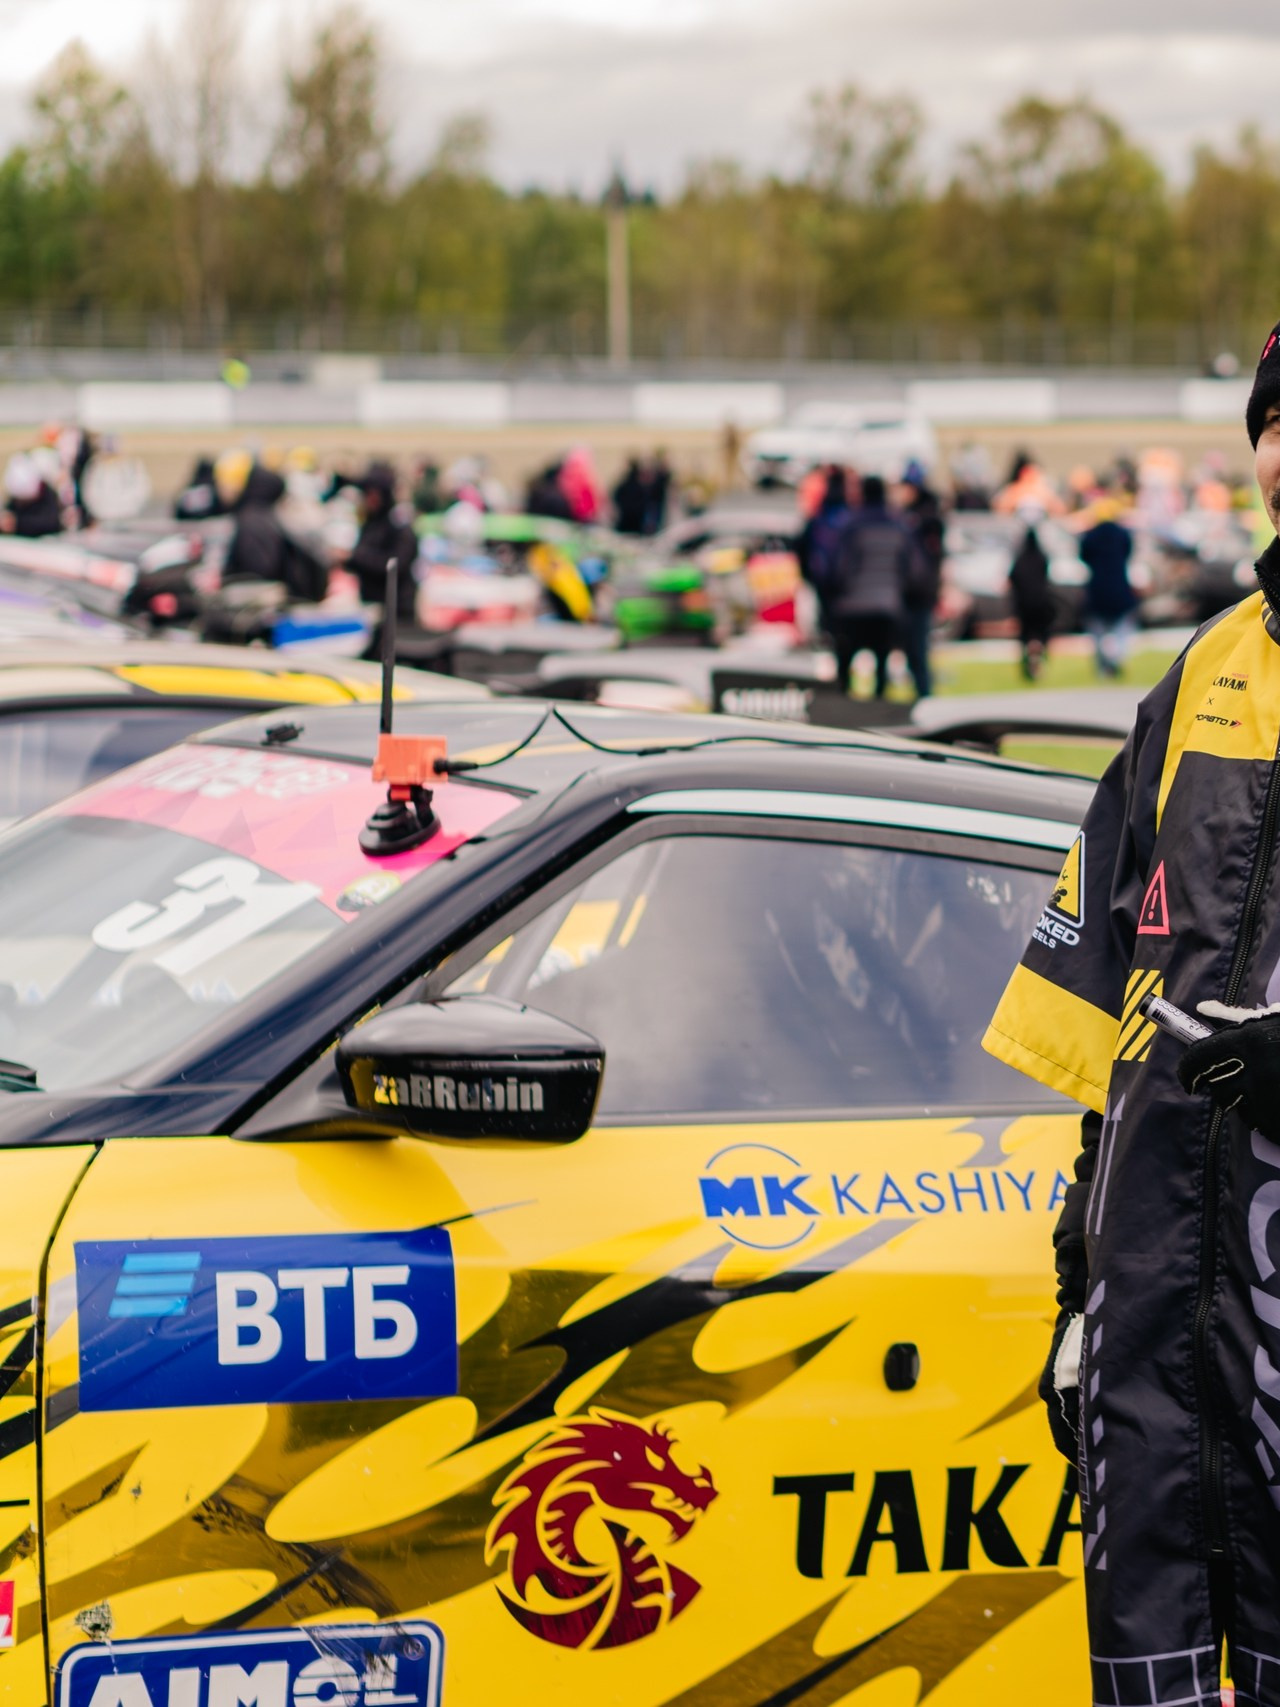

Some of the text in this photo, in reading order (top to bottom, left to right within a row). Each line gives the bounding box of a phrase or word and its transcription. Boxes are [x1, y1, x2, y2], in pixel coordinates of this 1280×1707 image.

[92, 857, 323, 976] 31
[699, 1174, 822, 1218] MK
[216, 1264, 418, 1365] ВТБ
